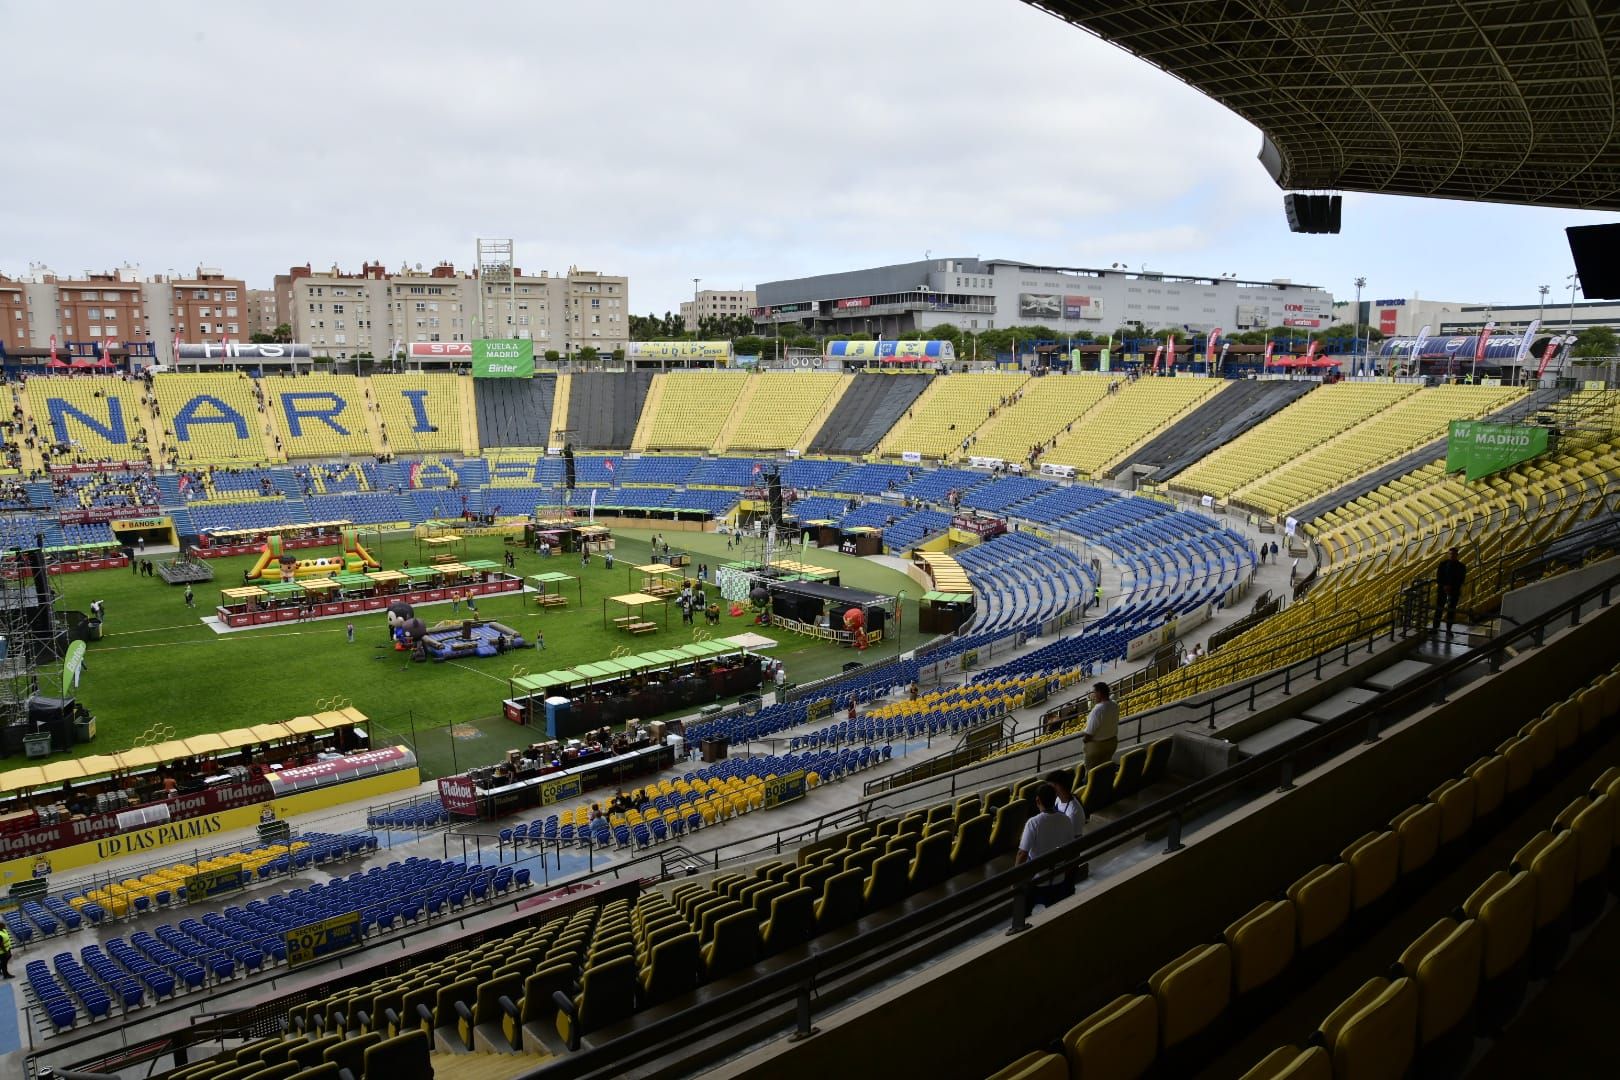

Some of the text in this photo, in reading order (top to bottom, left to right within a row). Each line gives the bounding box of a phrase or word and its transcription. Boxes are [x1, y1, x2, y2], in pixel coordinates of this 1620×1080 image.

[204, 344, 284, 358] HPS
[1390, 340, 1429, 348] PEPI
[488, 364, 518, 373] Binter
[1476, 433, 1530, 446] MADRID
[343, 748, 394, 764] Mahou
[283, 762, 336, 777] Mahou
[441, 780, 472, 799] Mahou
[97, 815, 222, 858] UD LAS PALMAS
[294, 924, 323, 937] SECTOR
